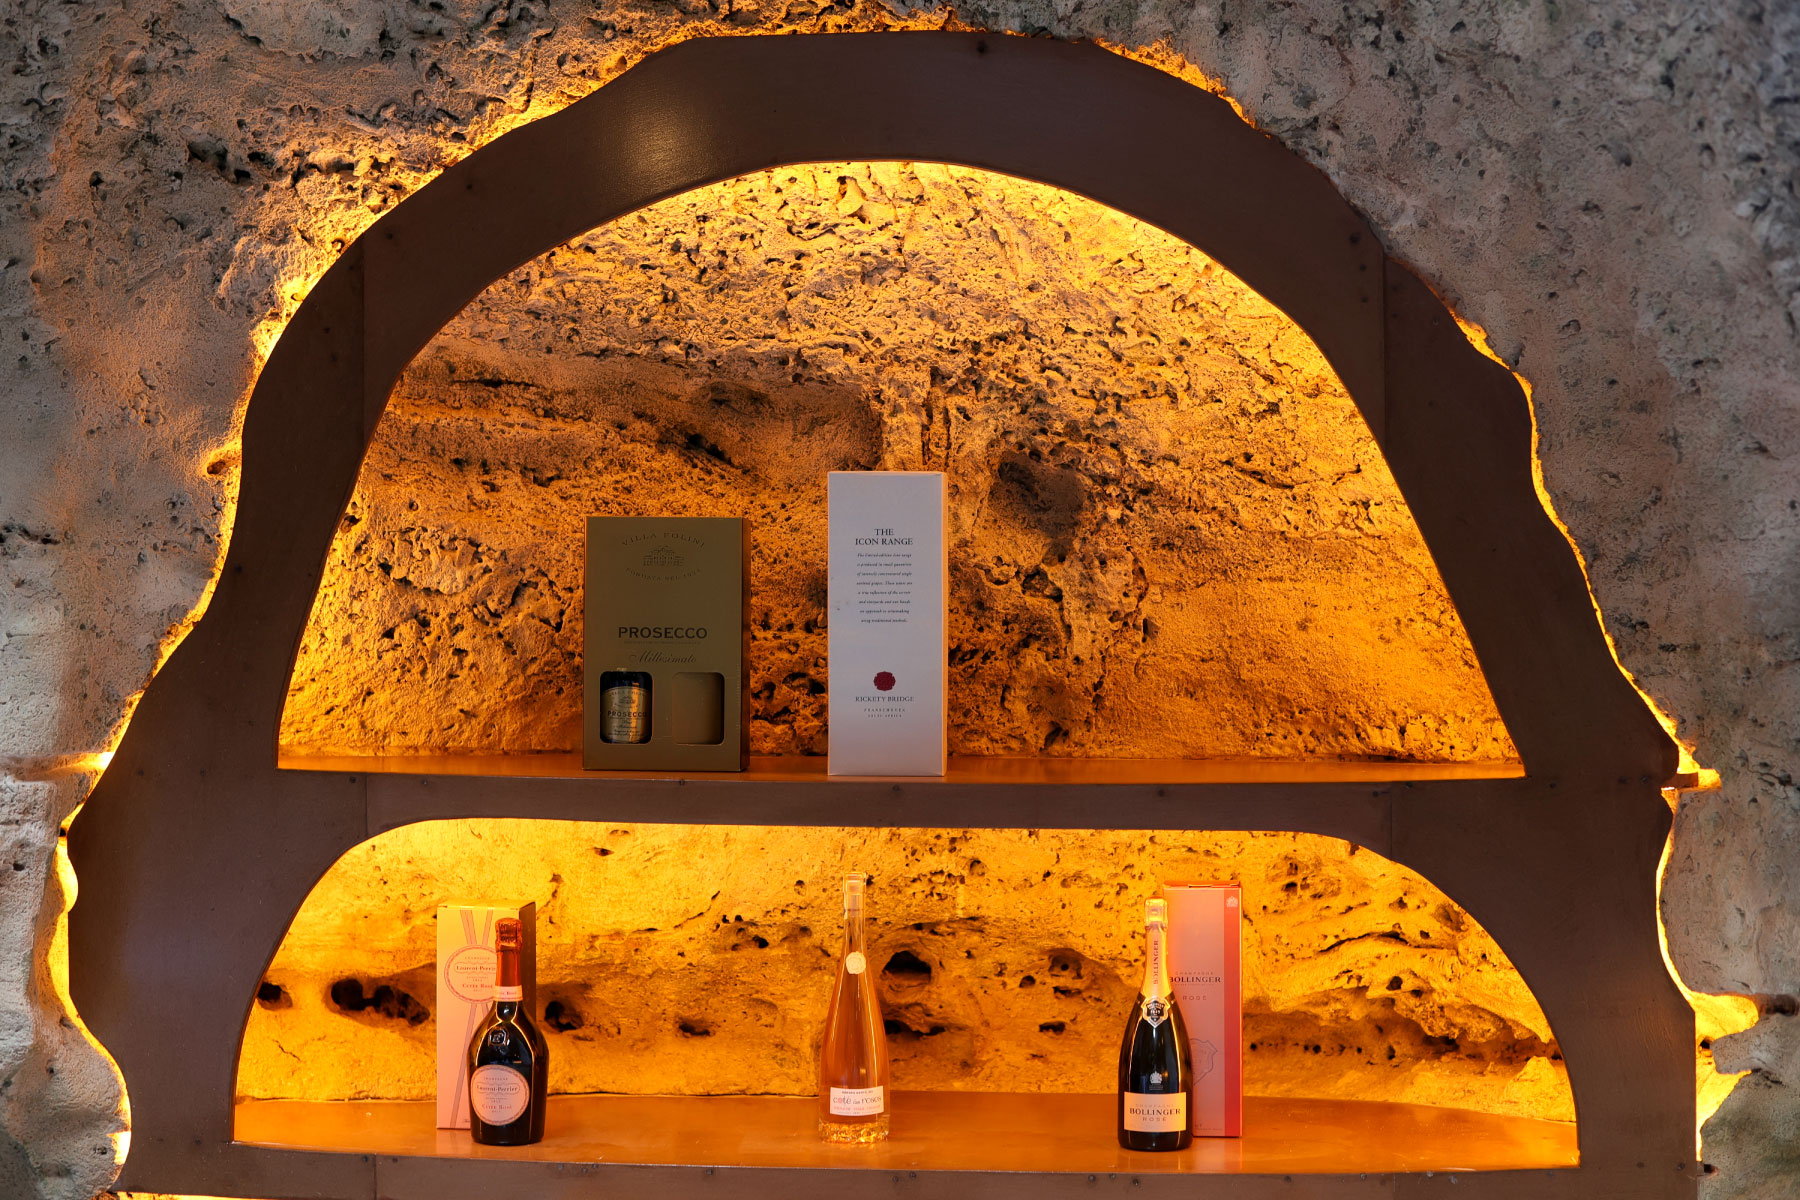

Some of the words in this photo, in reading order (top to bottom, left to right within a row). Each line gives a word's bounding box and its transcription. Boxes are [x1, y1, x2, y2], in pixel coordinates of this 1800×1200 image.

[874, 528, 894, 536] THE
[622, 532, 657, 546] VILLA
[618, 626, 708, 639] PROSECCO
[607, 710, 647, 718] PROSECCO
[1129, 1107, 1181, 1116] BOLLINGER
